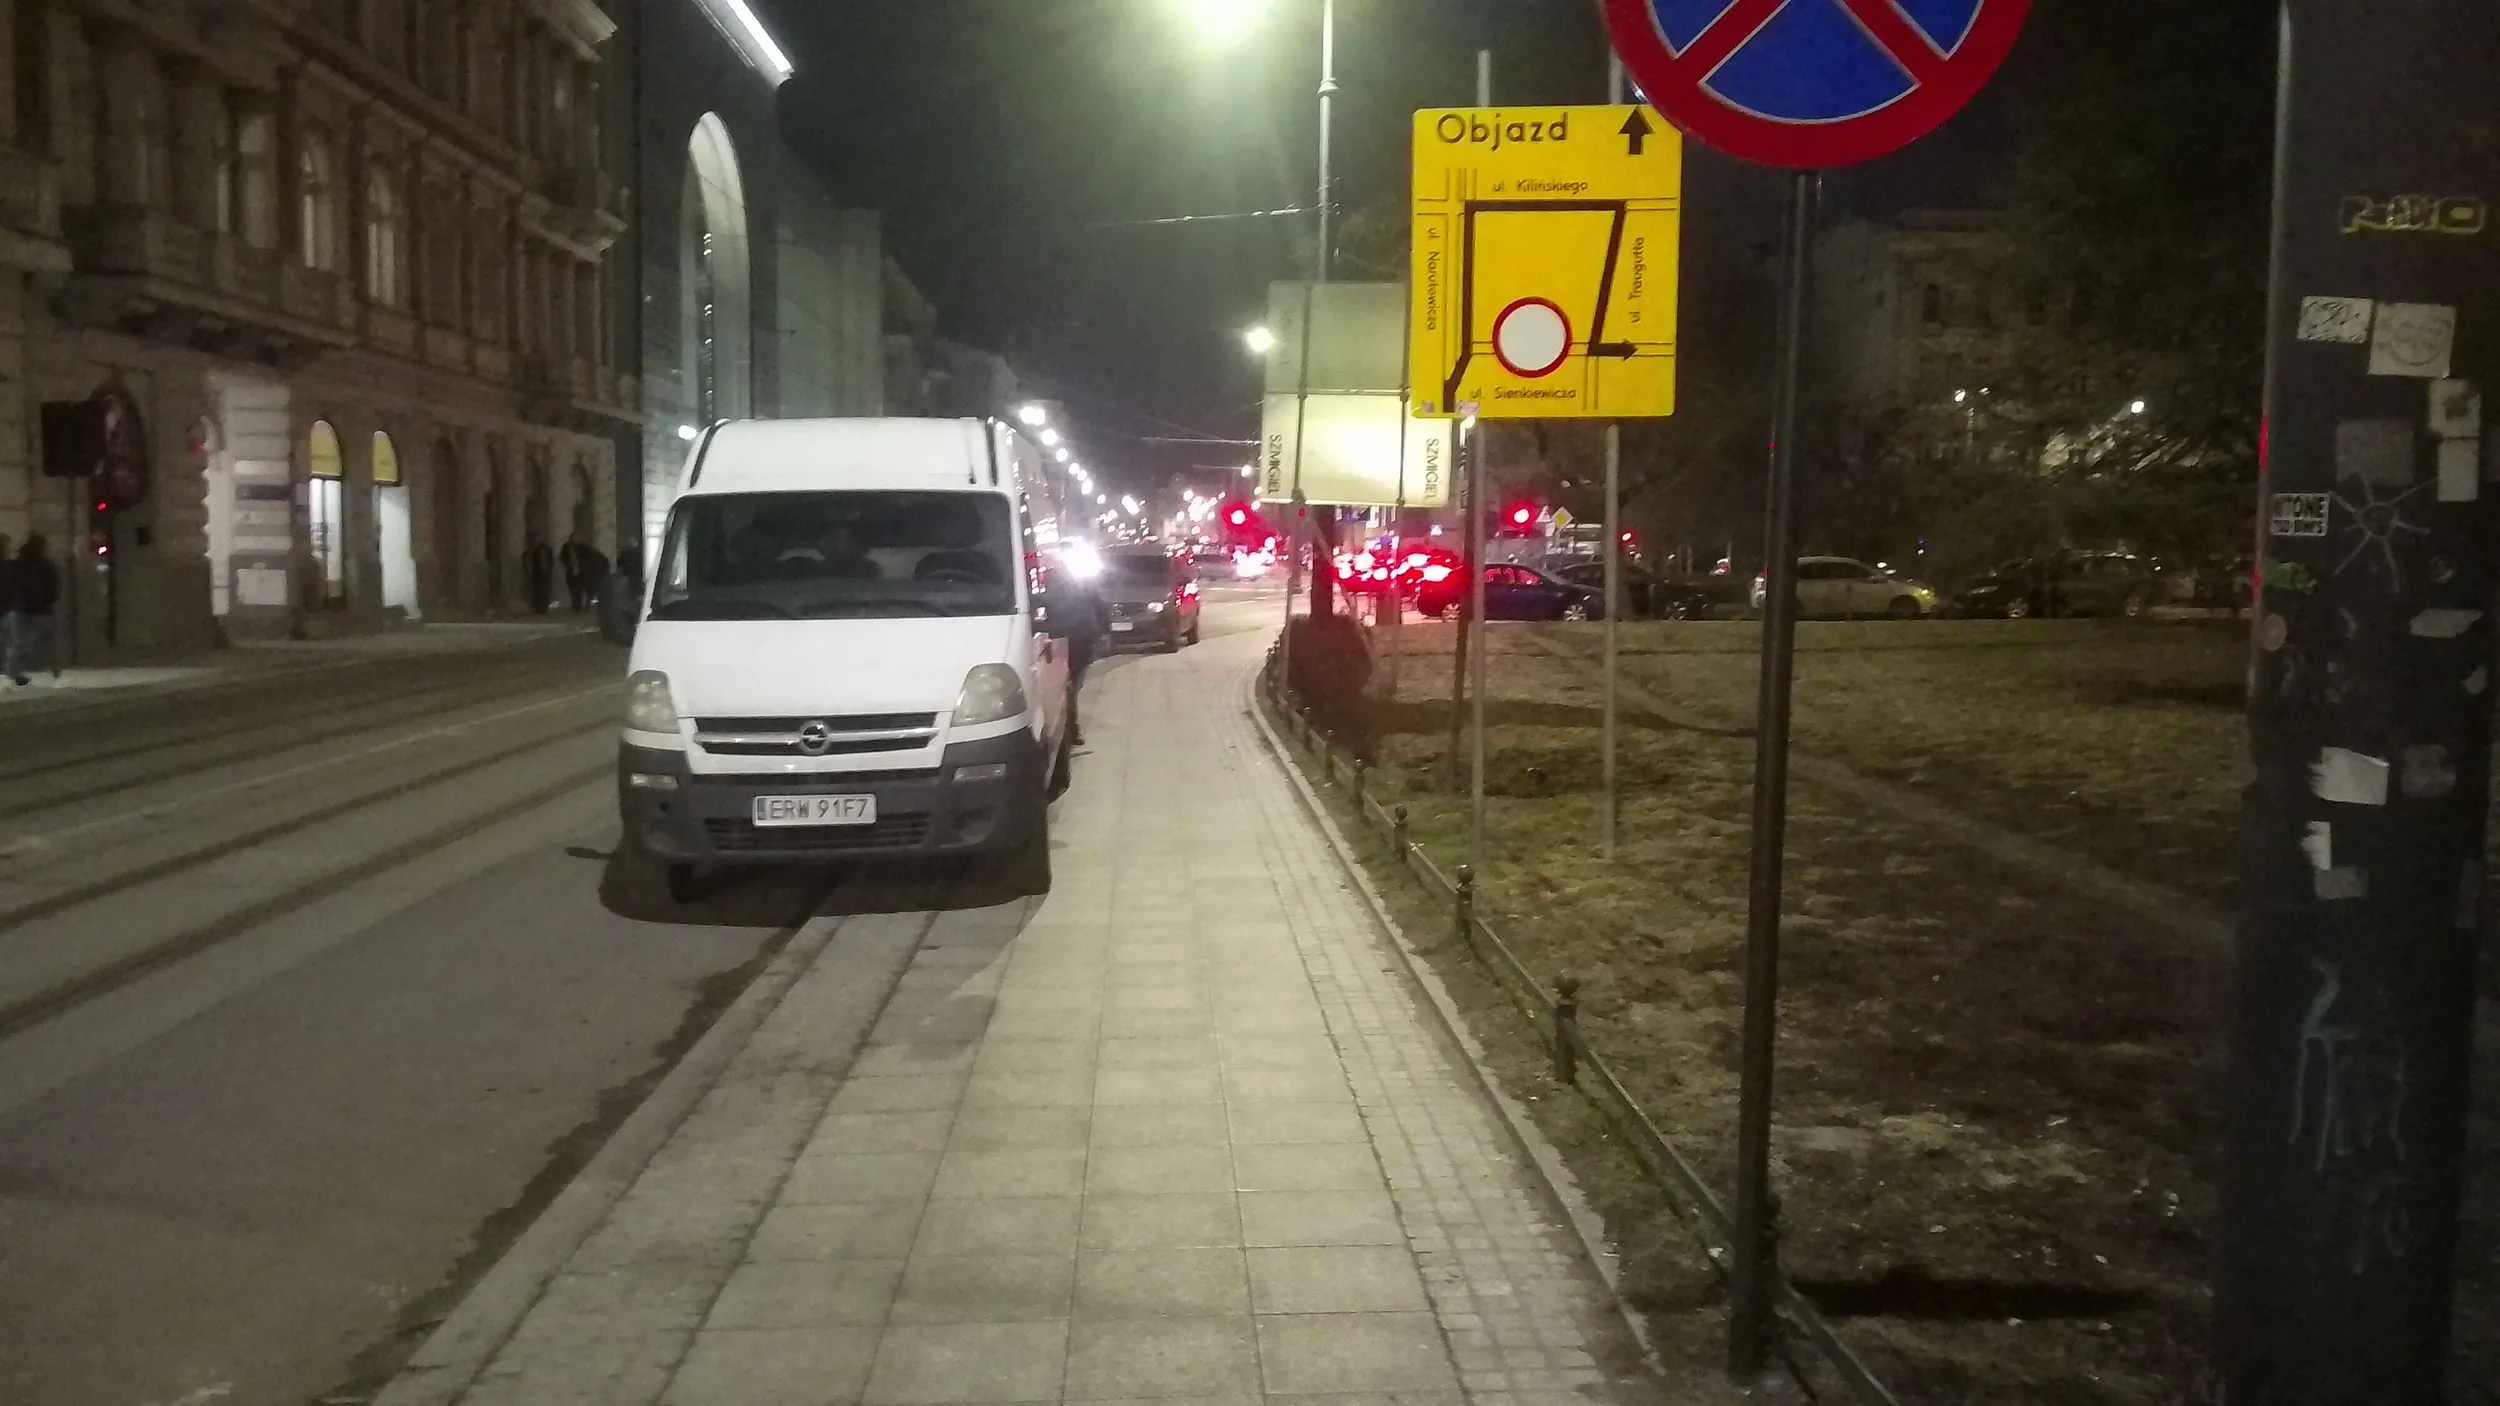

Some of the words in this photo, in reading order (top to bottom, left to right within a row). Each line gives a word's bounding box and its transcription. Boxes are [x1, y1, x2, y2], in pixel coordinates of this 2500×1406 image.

[1437, 112, 1569, 151] Objazd
[1516, 179, 1589, 195] Kilińskiego
[1427, 251, 1440, 331] Narutowicza
[1628, 237, 1647, 300] Traugutta
[1494, 386, 1577, 399] Sienkiewicza
[1268, 434, 1282, 494] SZMIGIEL
[1425, 438, 1439, 499] SZMIGIEL
[769, 799, 810, 820] ERW
[818, 798, 868, 819] 91F7
